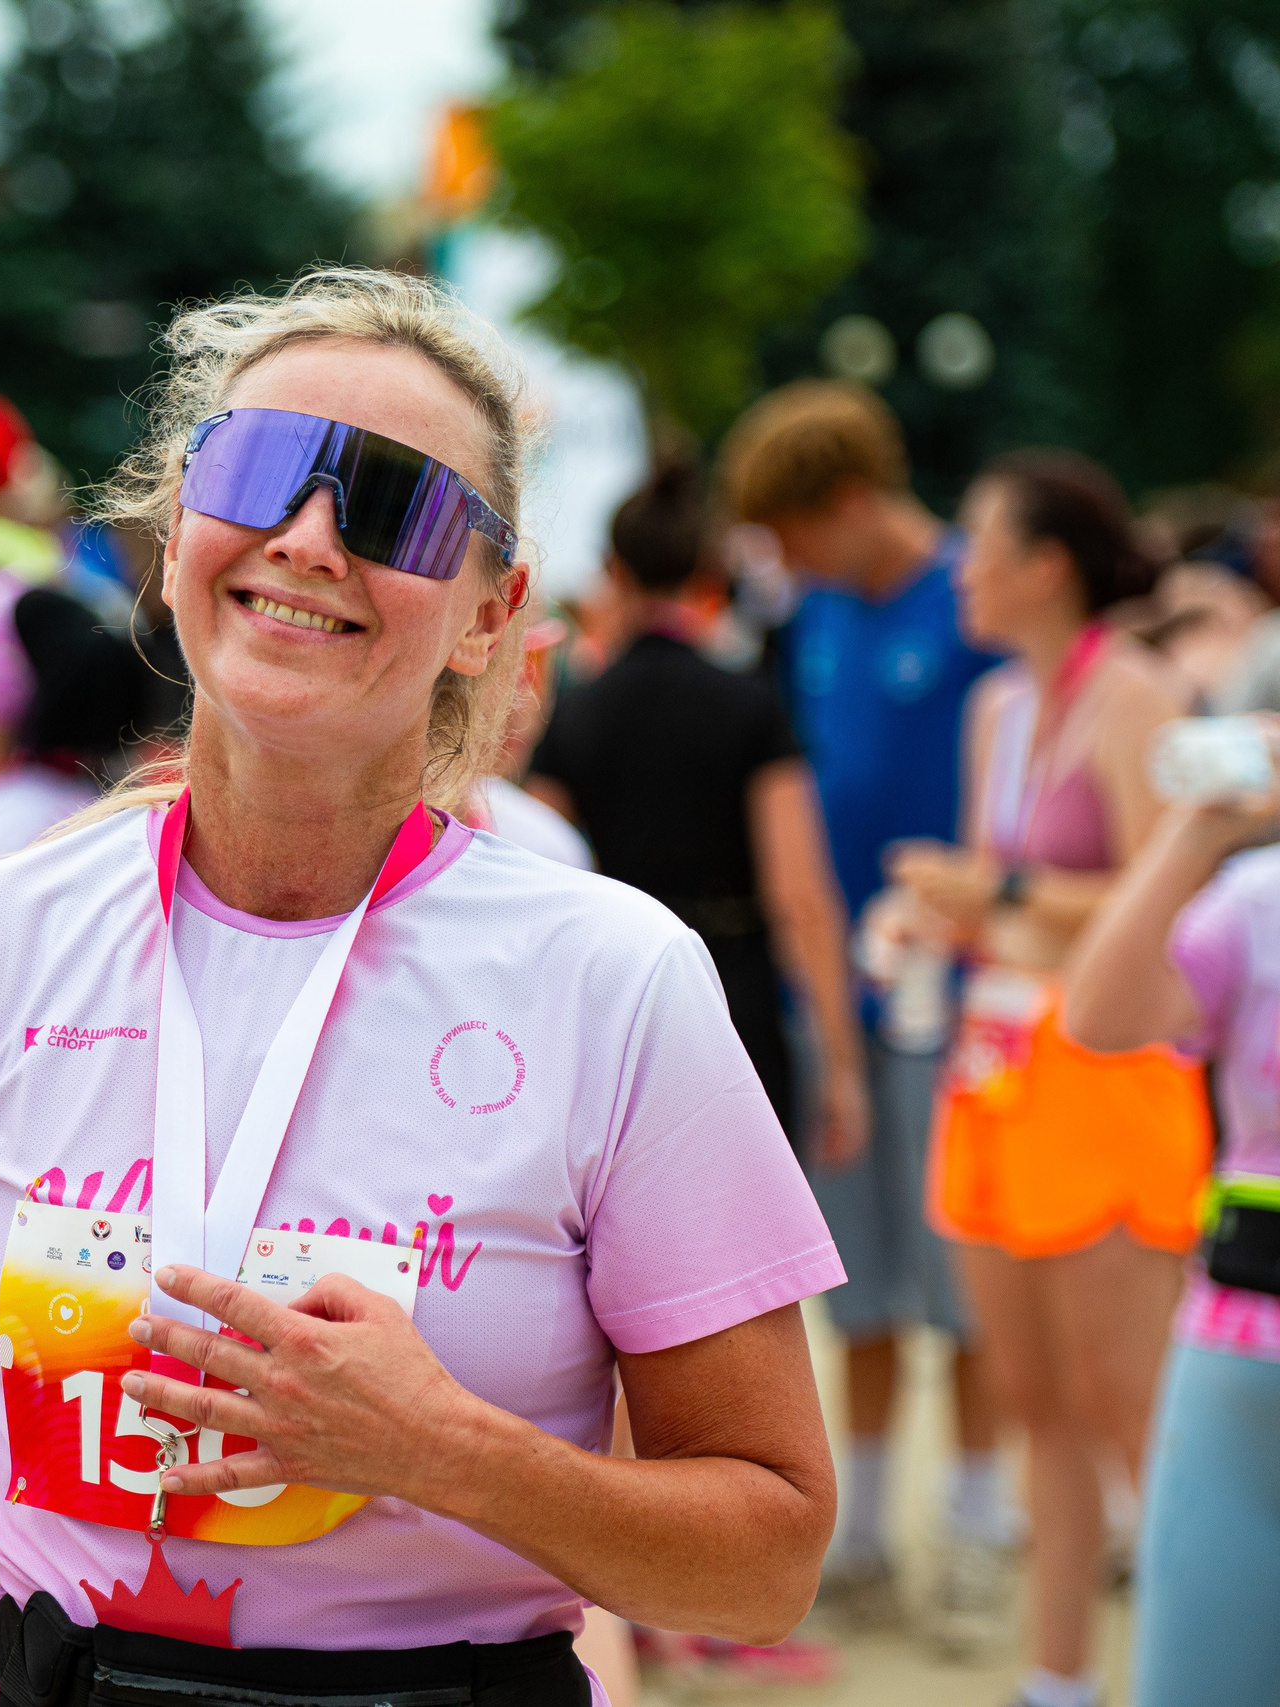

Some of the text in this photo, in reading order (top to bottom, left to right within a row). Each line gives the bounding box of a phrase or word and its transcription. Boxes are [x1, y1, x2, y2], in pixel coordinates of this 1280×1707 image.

[47, 1035, 95, 1050] СПОРТ
[49, 1025, 147, 1040] КАЛАШНИКОВ
[430, 1020, 488, 1109] КЛУБ БЕГОВЫХ ПРИНЦЕСС
[470, 1029, 526, 1115] КЛУБ БЕГОВЫХ ПРИНЦЕСС
